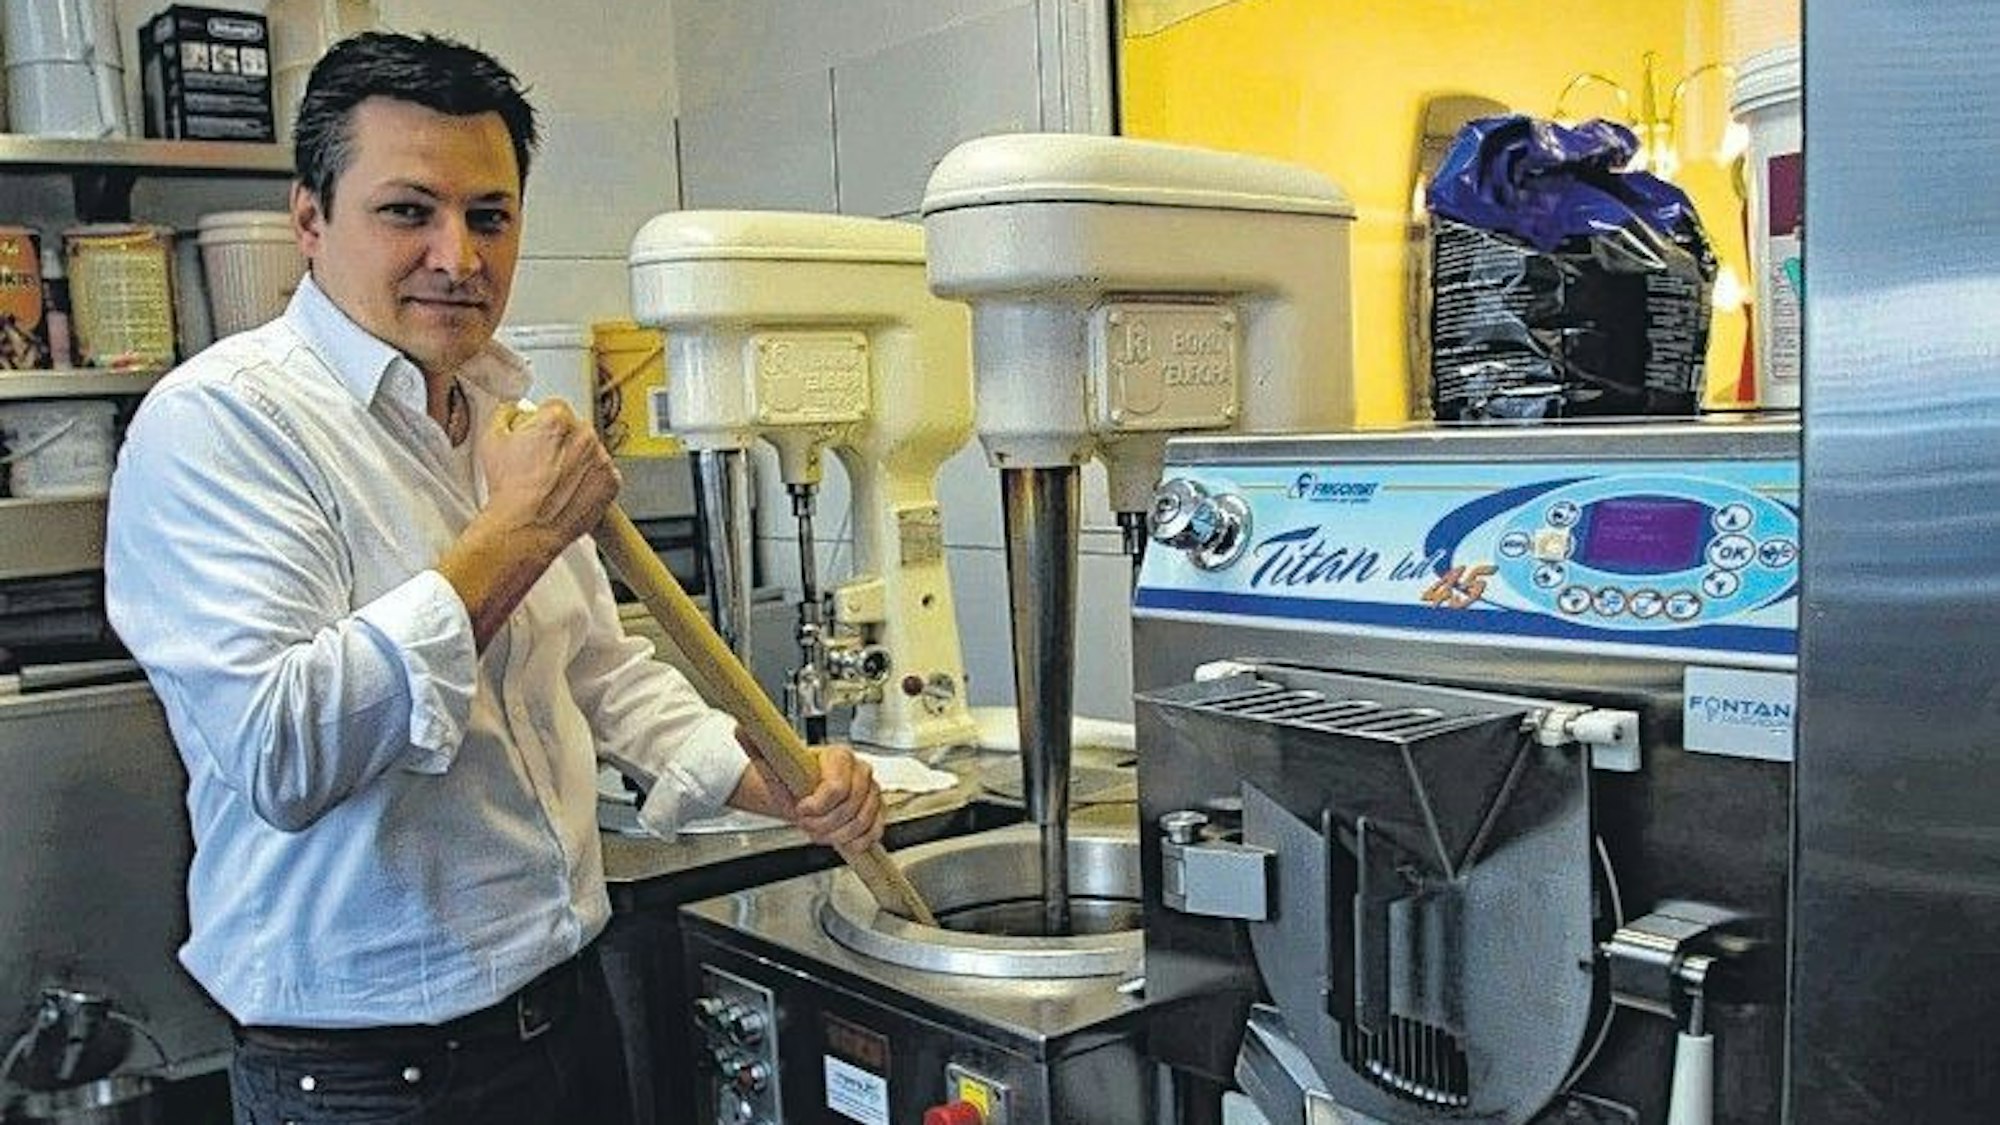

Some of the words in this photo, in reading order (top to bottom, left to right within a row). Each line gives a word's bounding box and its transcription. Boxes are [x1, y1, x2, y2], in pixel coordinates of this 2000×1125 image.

[1719, 546, 1750, 560] OK
[1251, 524, 1380, 588] Titan
[1420, 565, 1500, 609] 45
[1688, 695, 1791, 719] FONTAN
